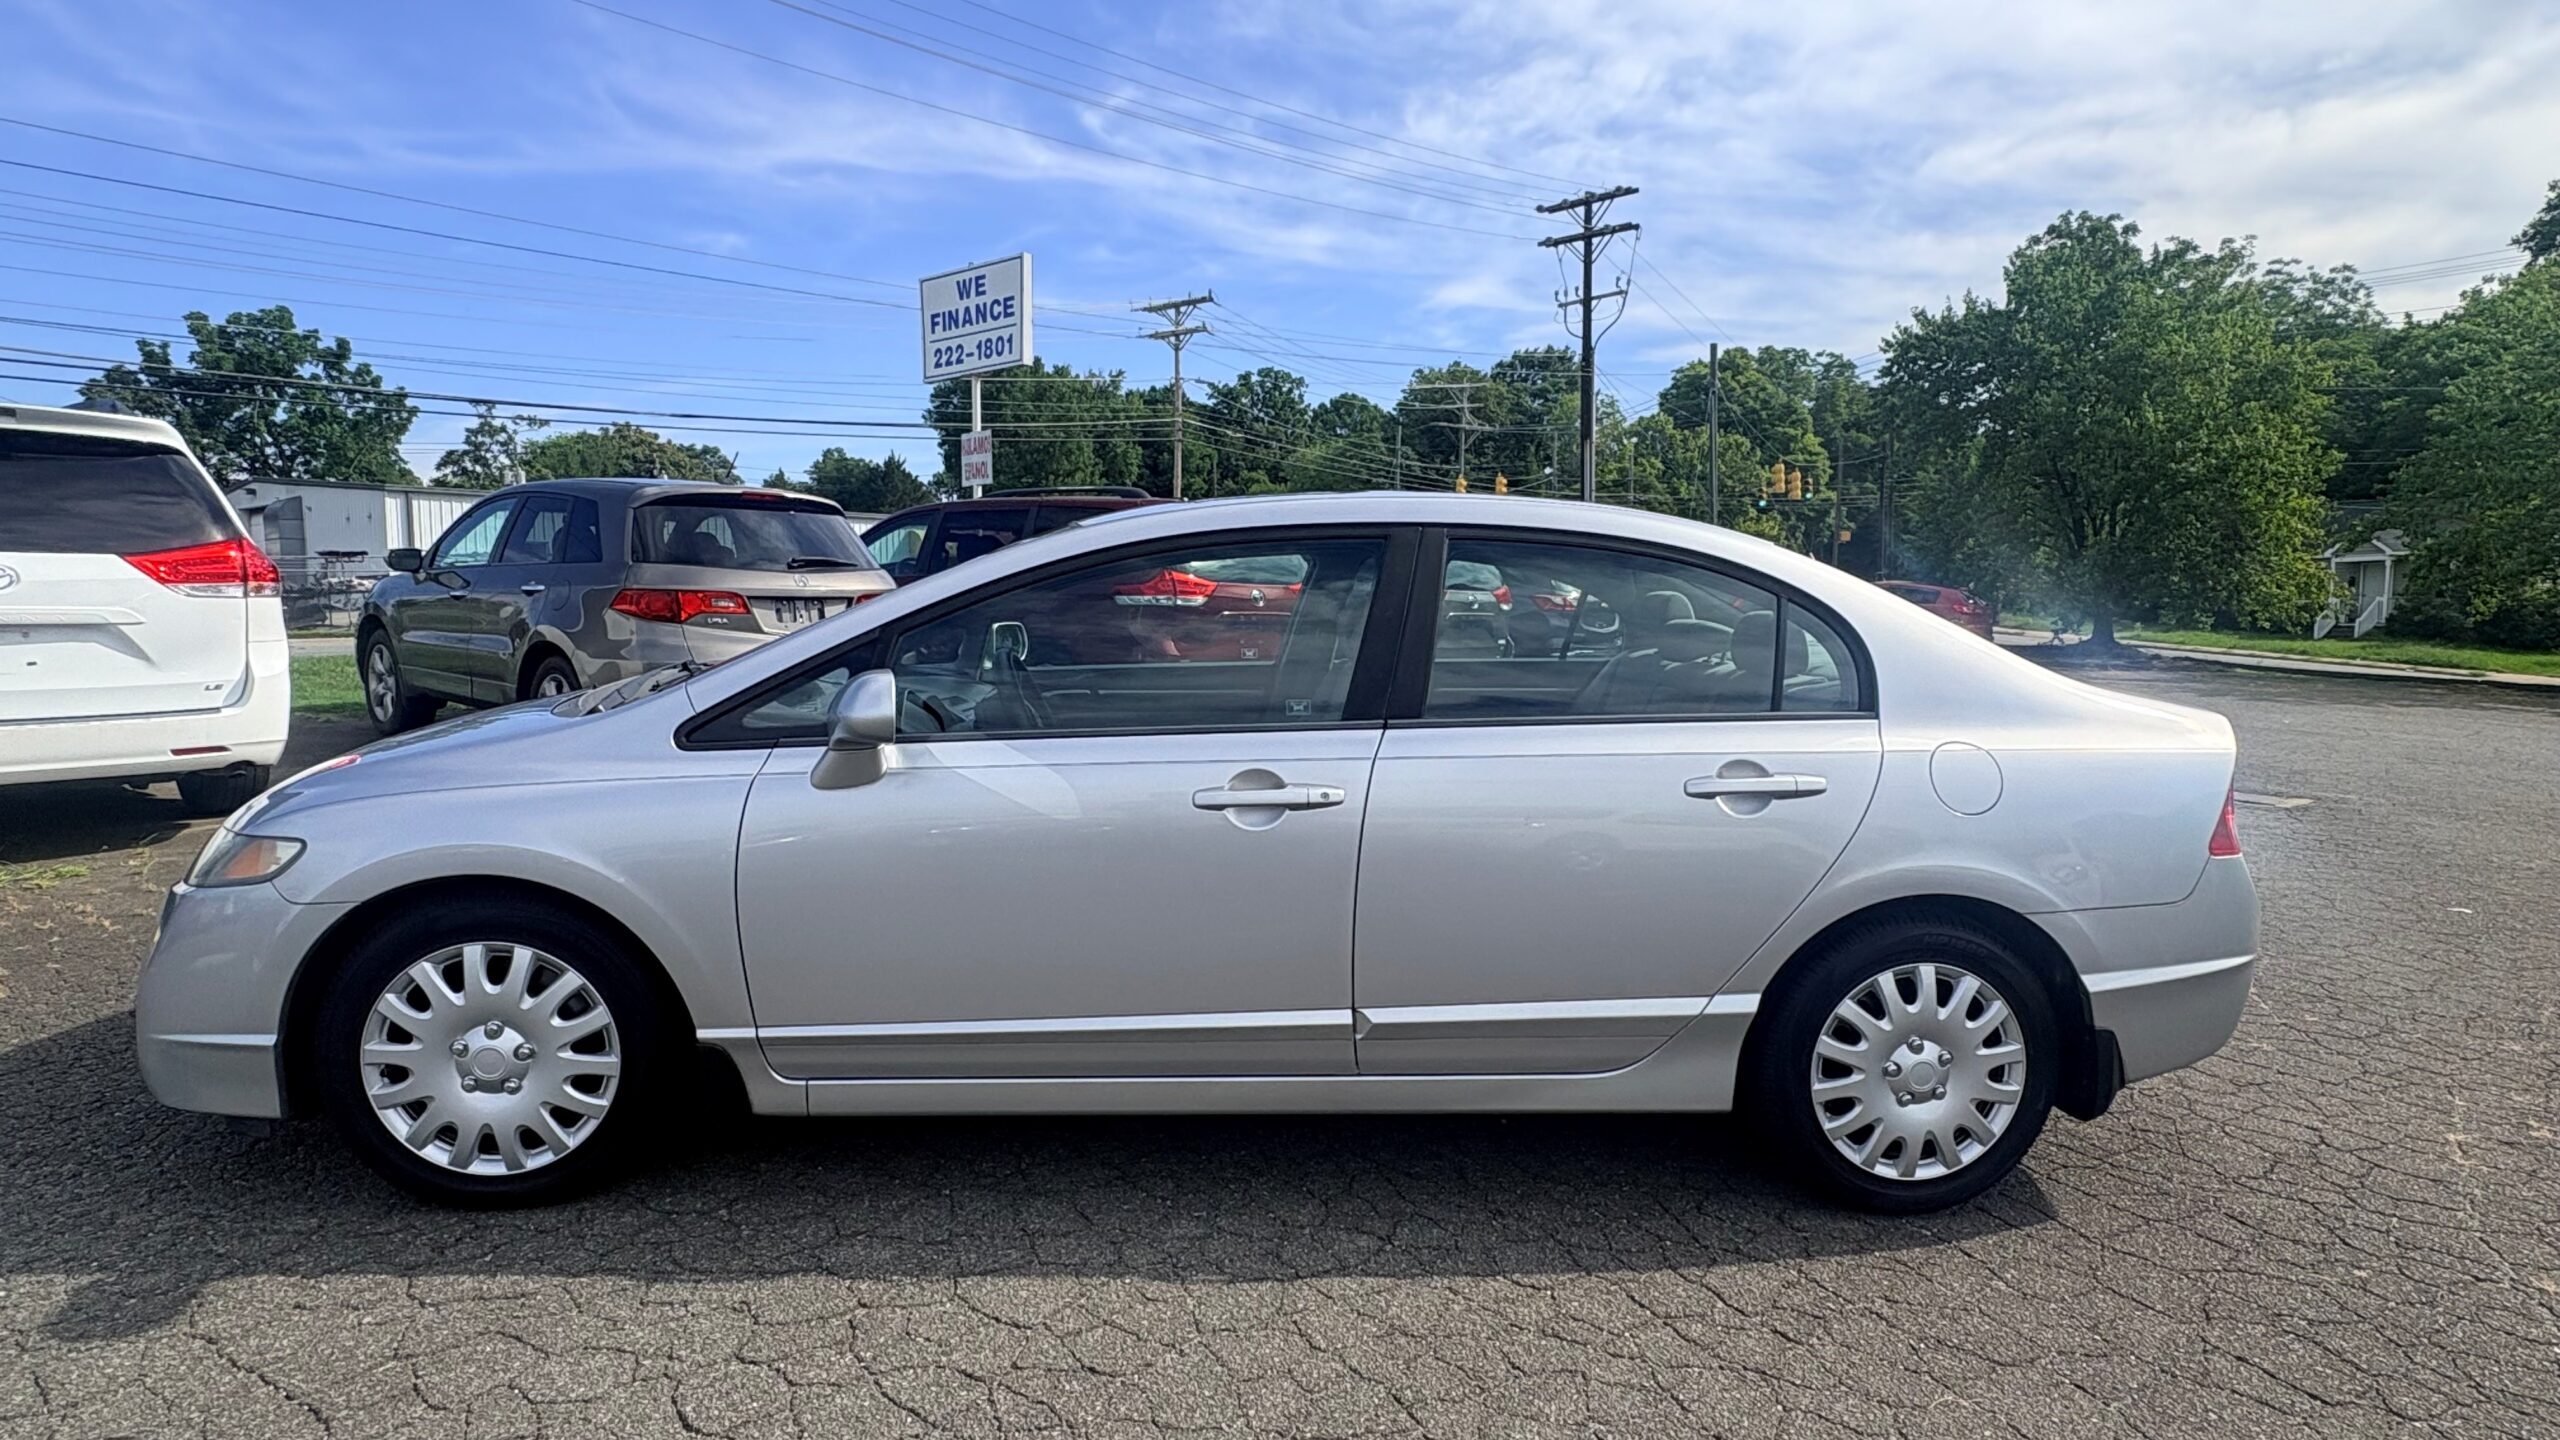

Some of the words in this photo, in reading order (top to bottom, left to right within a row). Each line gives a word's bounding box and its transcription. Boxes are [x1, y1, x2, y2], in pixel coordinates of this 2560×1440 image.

[956, 274, 986, 301] WE
[930, 295, 1015, 335] FINANCE
[933, 333, 1013, 369] 222-1801
